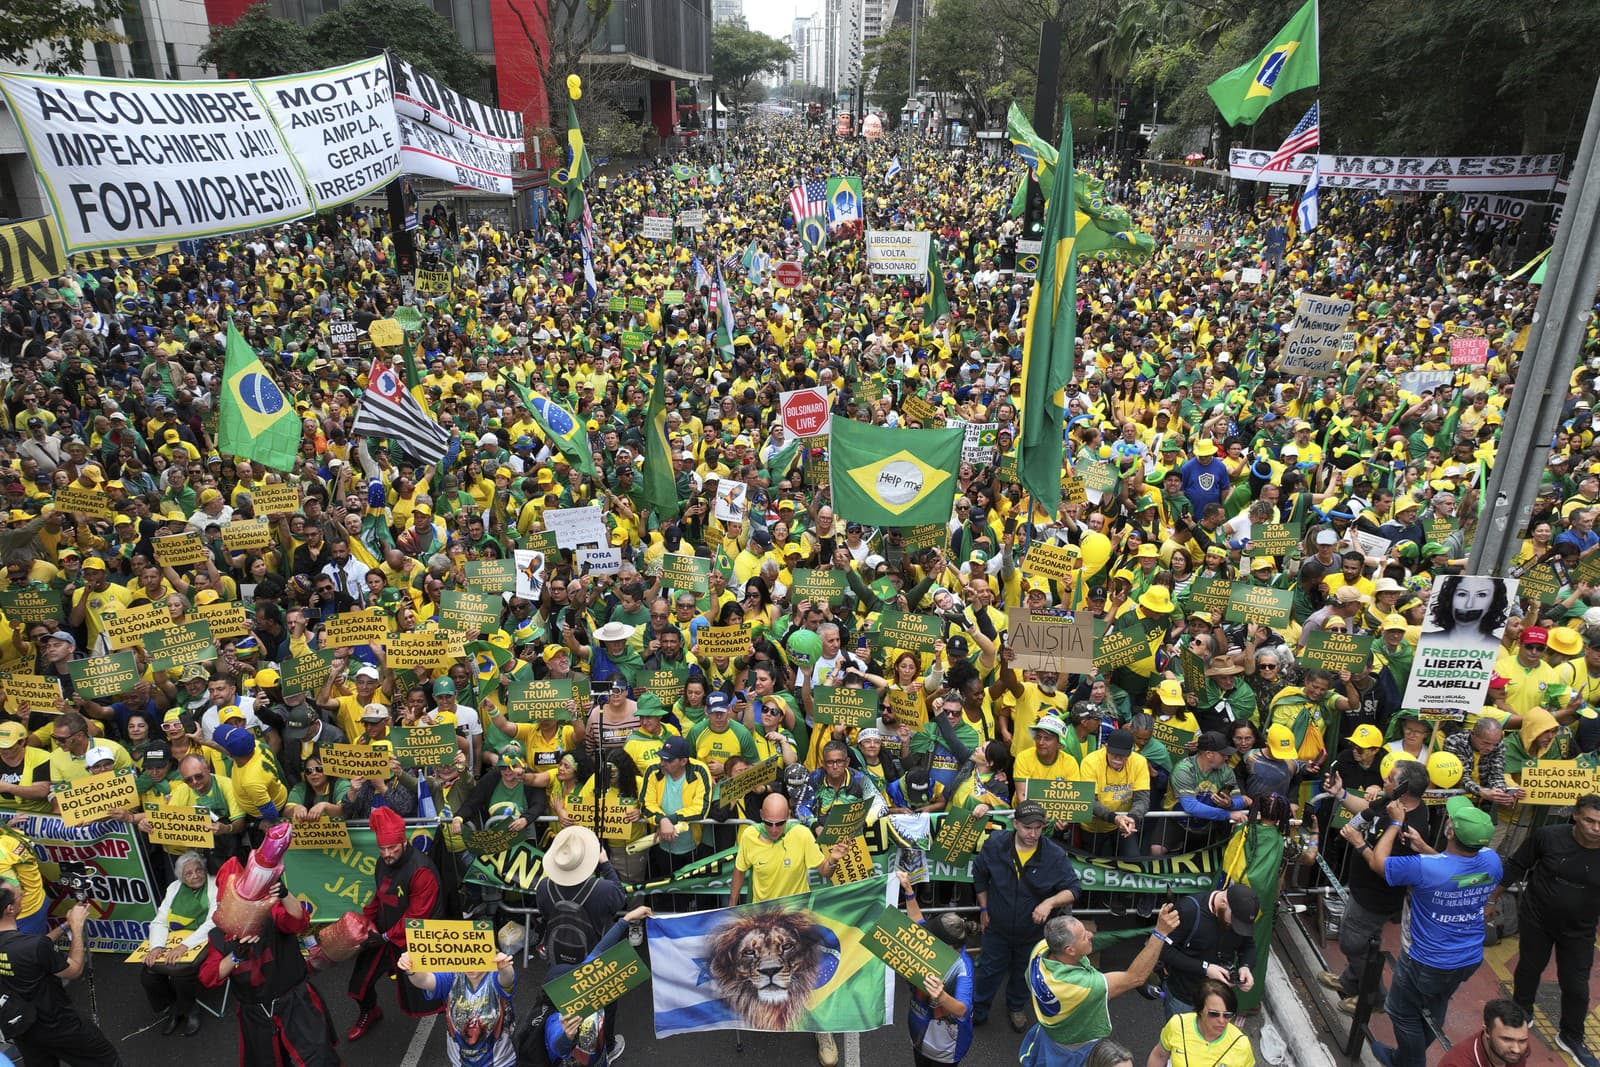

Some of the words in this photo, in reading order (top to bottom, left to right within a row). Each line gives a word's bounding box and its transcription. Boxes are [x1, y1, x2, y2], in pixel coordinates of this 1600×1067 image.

[276, 67, 389, 109] MOTTA
[33, 87, 261, 125] ALCOLUMBRE
[291, 100, 363, 129] ANISTIA
[477, 103, 523, 140] LULA
[323, 115, 384, 146] AMPLA,
[46, 132, 234, 166] IMPEACHMENT
[235, 124, 278, 159] JÁ!!!
[328, 139, 383, 169] GERAL
[383, 132, 394, 148] E
[1231, 150, 1317, 170] FOA
[1334, 153, 1560, 176] MORAES!!!
[315, 152, 400, 200] IRRESTRITA
[69, 180, 182, 233] FORA
[175, 167, 301, 223] MORAES!!!
[870, 236, 912, 244] LIBERDADE
[881, 249, 906, 257] VOLTA
[869, 262, 917, 270] BOLSONARO
[418, 270, 449, 281] ANISTIA
[783, 277, 796, 285] LIVRE
[1307, 299, 1350, 317] TRUMP
[330, 323, 355, 334] FORA
[1300, 334, 1322, 345] LAW
[1323, 335, 1339, 348] FOR
[1289, 341, 1322, 357] GLOBO
[787, 404, 823, 416] BOLSONARO
[796, 418, 816, 430] LIVRE
[880, 473, 902, 489] Help
[254, 495, 297, 505] BOLSONARO
[1032, 548, 1058, 560] ELEIÇÃO
[1026, 554, 1072, 572] BOLSONARO
[477, 567, 505, 575] TRUMP
[1034, 566, 1064, 578] DITADURA
[469, 576, 512, 585] BOLSONARO
[664, 573, 704, 582] BOLSONARO
[806, 578, 835, 586] TRUMP
[482, 584, 503, 592] FREE
[674, 580, 694, 589] FREE
[1252, 587, 1272, 596] SOS
[808, 596, 830, 604] FREE
[1245, 594, 1279, 605] TRUMP
[1232, 604, 1285, 618] BOLSONARO
[1245, 614, 1271, 624] FREE
[702, 630, 731, 639] ELEIÇÃO
[1010, 623, 1083, 652] ANISTIA
[1330, 634, 1352, 642] SOS
[392, 639, 425, 648] ELEIÇÃO
[698, 637, 750, 645] BOLSONARO
[1322, 641, 1357, 650] TRUMP
[1308, 652, 1363, 663] BOLSONARO
[1422, 648, 1494, 660] FREEDOM
[88, 657, 111, 666] SOS
[1321, 660, 1348, 671] FREE
[83, 664, 120, 676] TRUMP
[1416, 669, 1489, 680] LIBERDADE
[76, 673, 133, 689] BOLSONARO
[1418, 679, 1481, 690] ZAMBELLI
[93, 684, 122, 696] FREE
[829, 696, 864, 705] TRUMP
[818, 707, 872, 718] BOLSONARO
[833, 716, 858, 726] FREE
[405, 736, 441, 745] TRUMP
[397, 746, 454, 756] BOLSONARO
[414, 756, 441, 765] FREE
[1528, 767, 1565, 778] ELEIÇÃO
[1567, 769, 1586, 777] SEM
[63, 782, 105, 799] ELEIÇÃO
[106, 777, 127, 788] SEM
[1522, 778, 1591, 790] BOLSONARO
[61, 785, 135, 812] BOLSONARO
[1537, 792, 1582, 800] DITADURA
[82, 798, 130, 817] DITADURA
[45, 839, 130, 862] TRUMP
[325, 877, 374, 907] JÁ!
[414, 929, 460, 942] ELEIÇÃO
[463, 932, 485, 940] SEM
[908, 924, 936, 946] SOS
[409, 943, 493, 954] BOLSONARO
[895, 927, 937, 960] TRUMP
[873, 930, 936, 978] BOLSONARO
[430, 957, 486, 966] DITADURA
[882, 952, 916, 979] FREE
[572, 957, 604, 981] SOS
[570, 960, 619, 995] TRUMP
[565, 965, 638, 1017] BOLSONARO
[591, 984, 629, 1011] FREE
